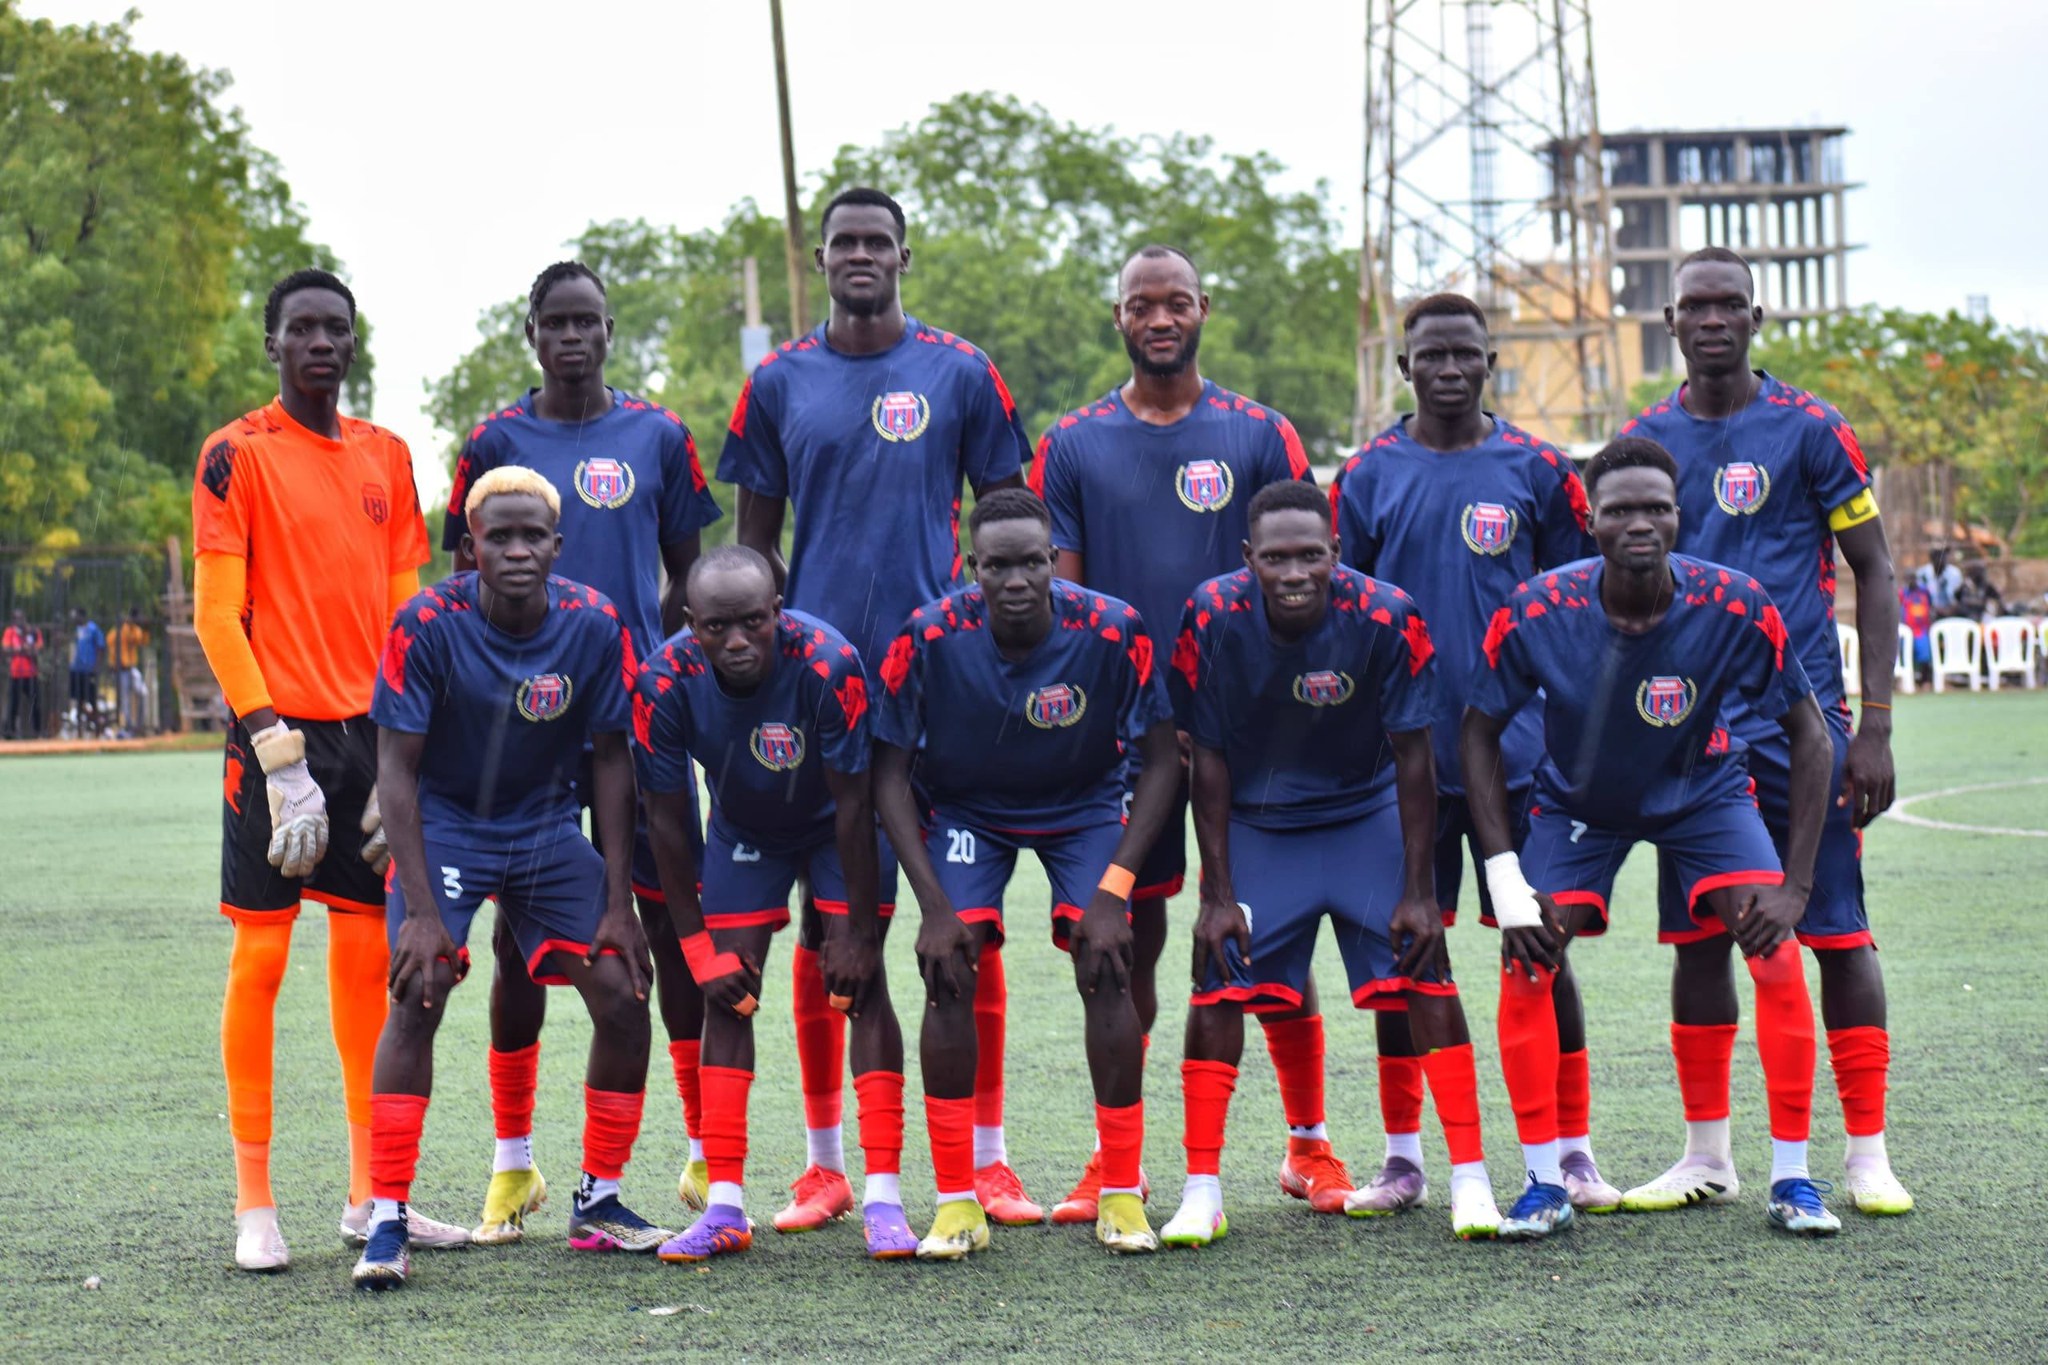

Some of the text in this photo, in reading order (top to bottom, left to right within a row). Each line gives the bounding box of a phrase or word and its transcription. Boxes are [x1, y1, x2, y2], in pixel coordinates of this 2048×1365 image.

[946, 829, 975, 864] 20
[1570, 820, 1587, 843] 7
[441, 866, 463, 899] 3
